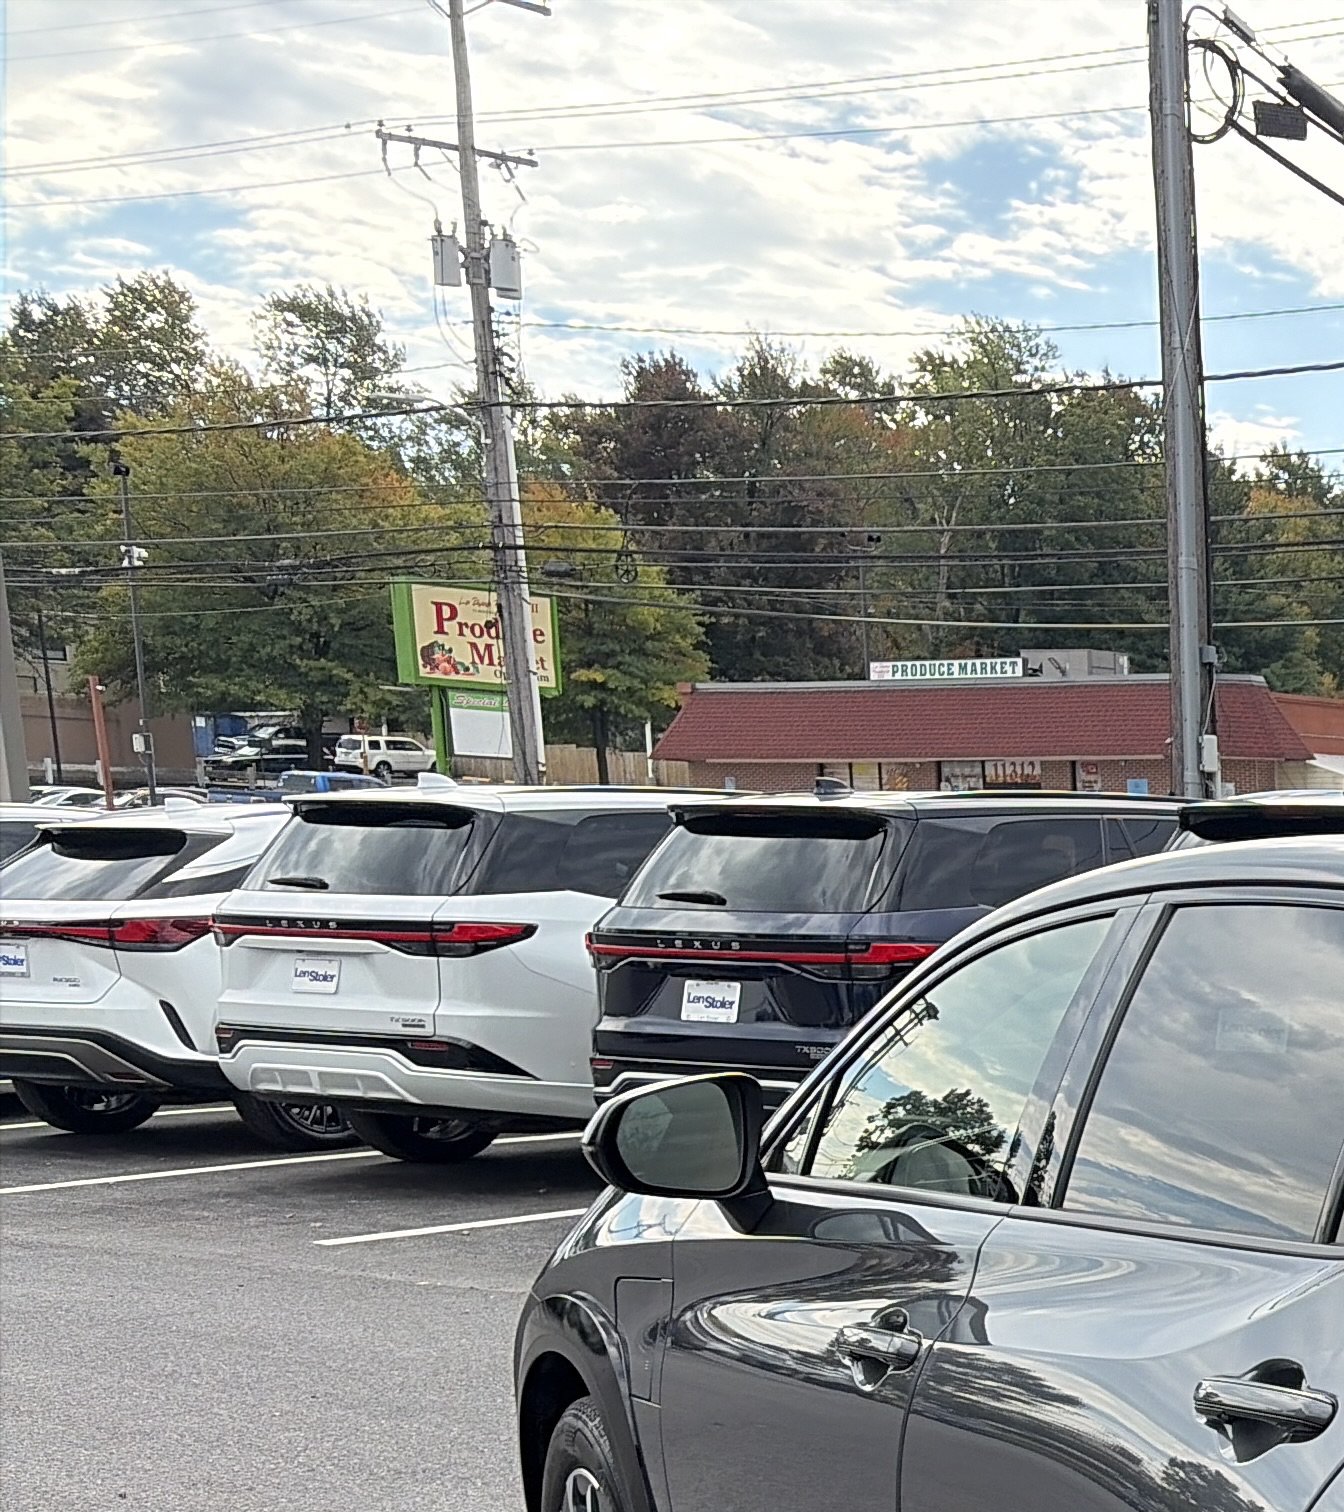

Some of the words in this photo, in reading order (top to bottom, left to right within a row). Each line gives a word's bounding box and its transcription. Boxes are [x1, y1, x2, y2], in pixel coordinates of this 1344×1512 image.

[431, 600, 546, 645] Prode
[891, 662, 954, 678] PRODUCE
[958, 660, 1019, 676] MARKET
[266, 920, 338, 929] LEXUS
[657, 938, 740, 950] LEXUS
